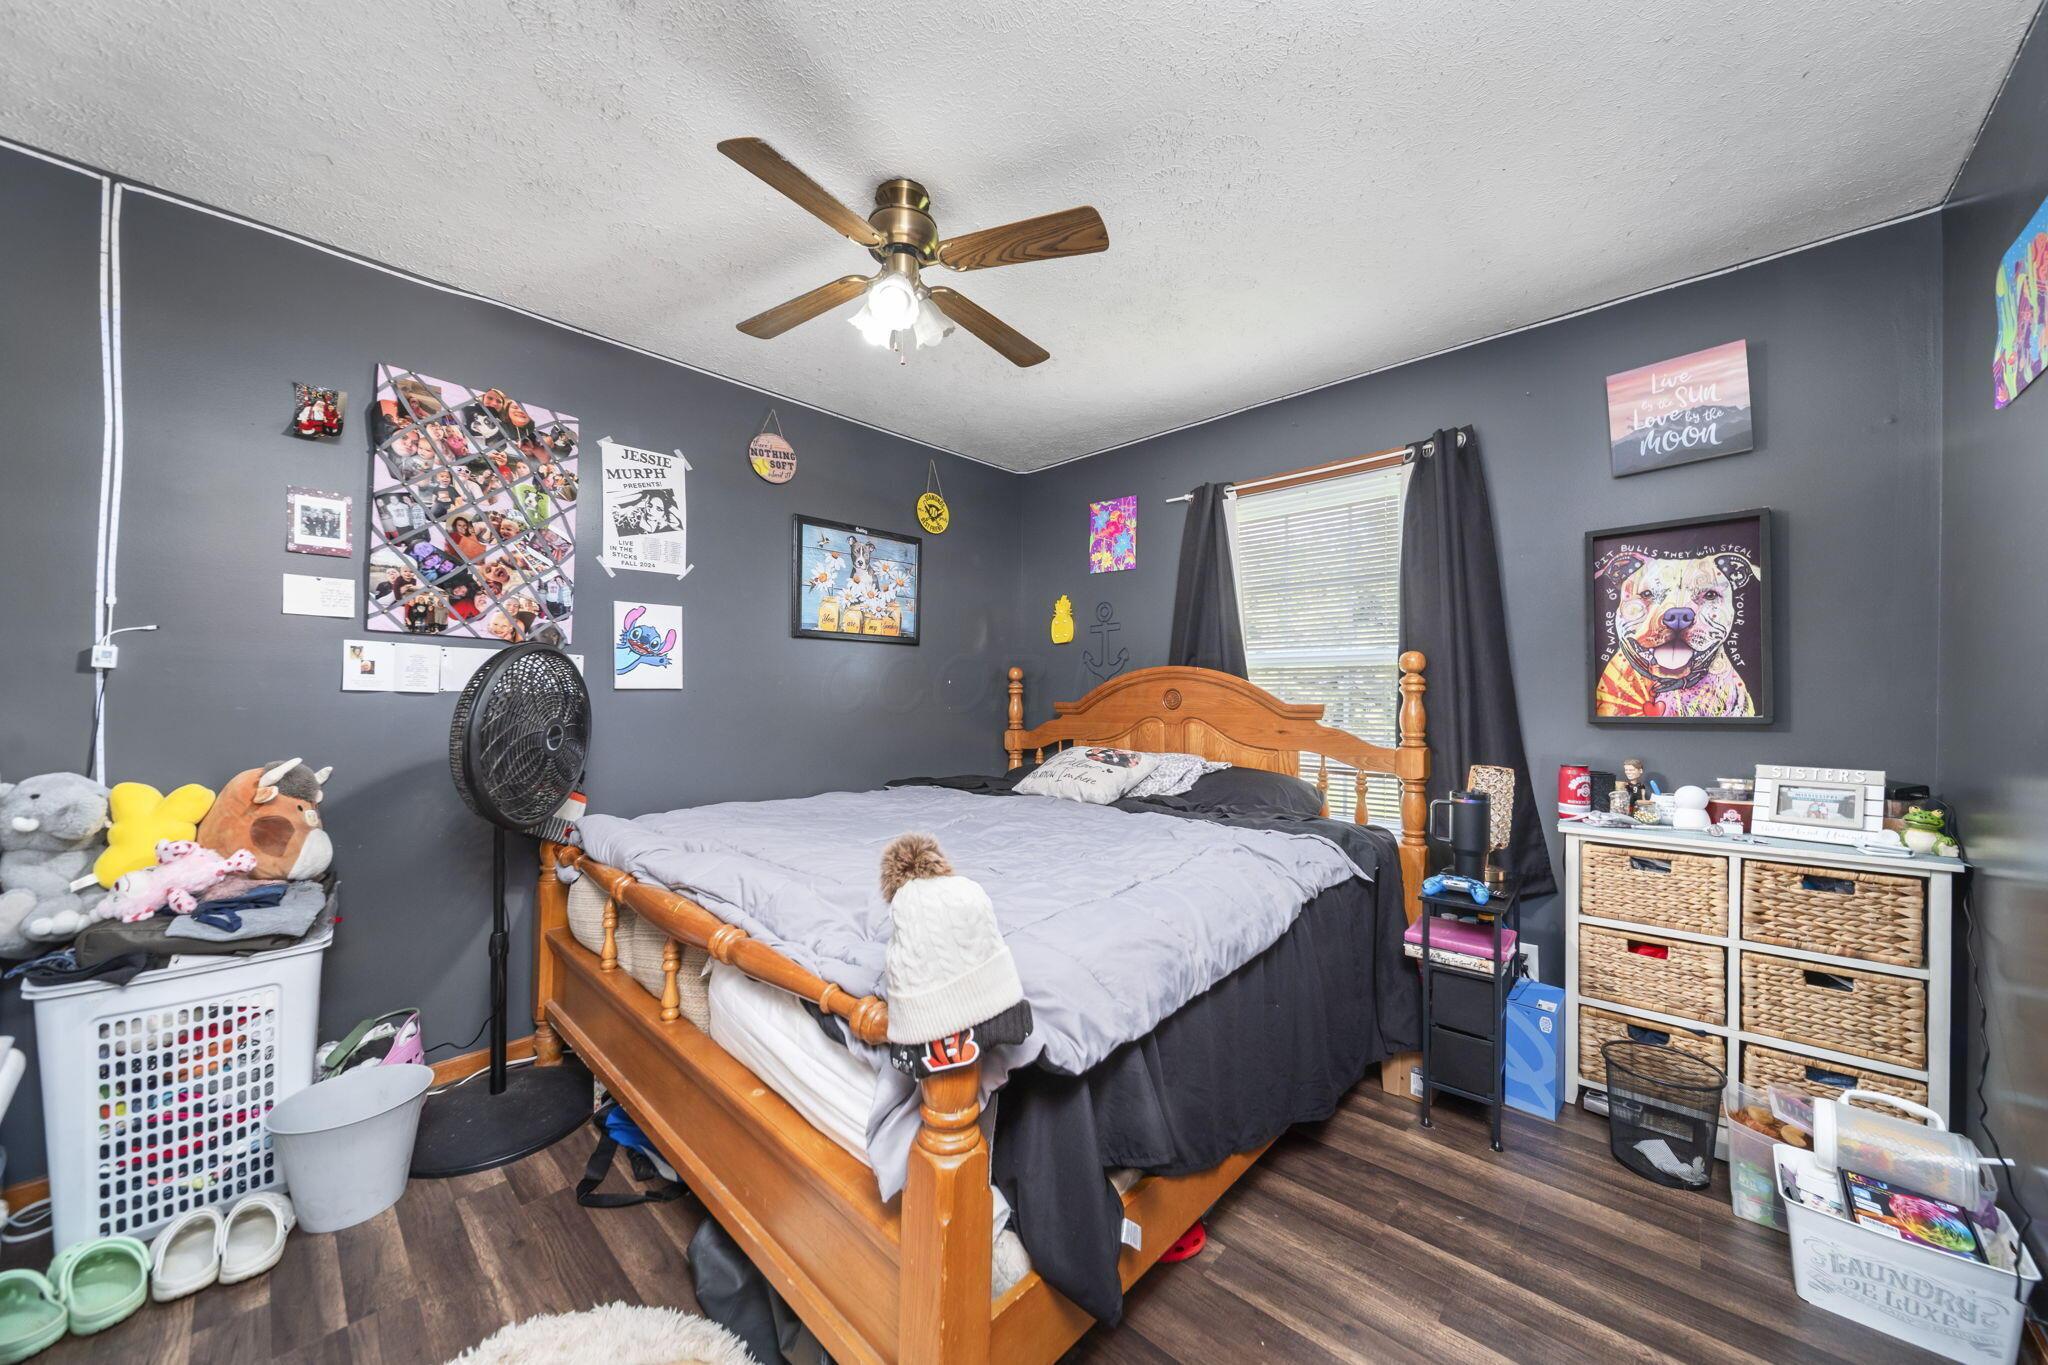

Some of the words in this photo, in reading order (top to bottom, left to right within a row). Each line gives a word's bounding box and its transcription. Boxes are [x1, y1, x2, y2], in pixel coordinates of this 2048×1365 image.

[1652, 370, 1692, 394] Live
[1633, 408, 1684, 431] Love
[1685, 411, 1700, 423] by
[1703, 408, 1725, 421] the
[621, 448, 672, 469] JESSIE
[750, 448, 796, 461] NOTHING
[770, 460, 794, 470] SOFT
[606, 468, 667, 480] MURPH
[612, 552, 638, 560] STICKS
[1620, 544, 1658, 558] BULLS
[1663, 550, 1691, 558] THEY
[1594, 551, 1613, 569] PIT
[1606, 587, 1617, 601] OF
[1734, 593, 1745, 626] YOUR
[1727, 633, 1745, 667] HEART
[1074, 772, 1097, 784] here
[1771, 766, 1867, 783] SISTERS
[1830, 1252, 1979, 1325] LAUNDRY
